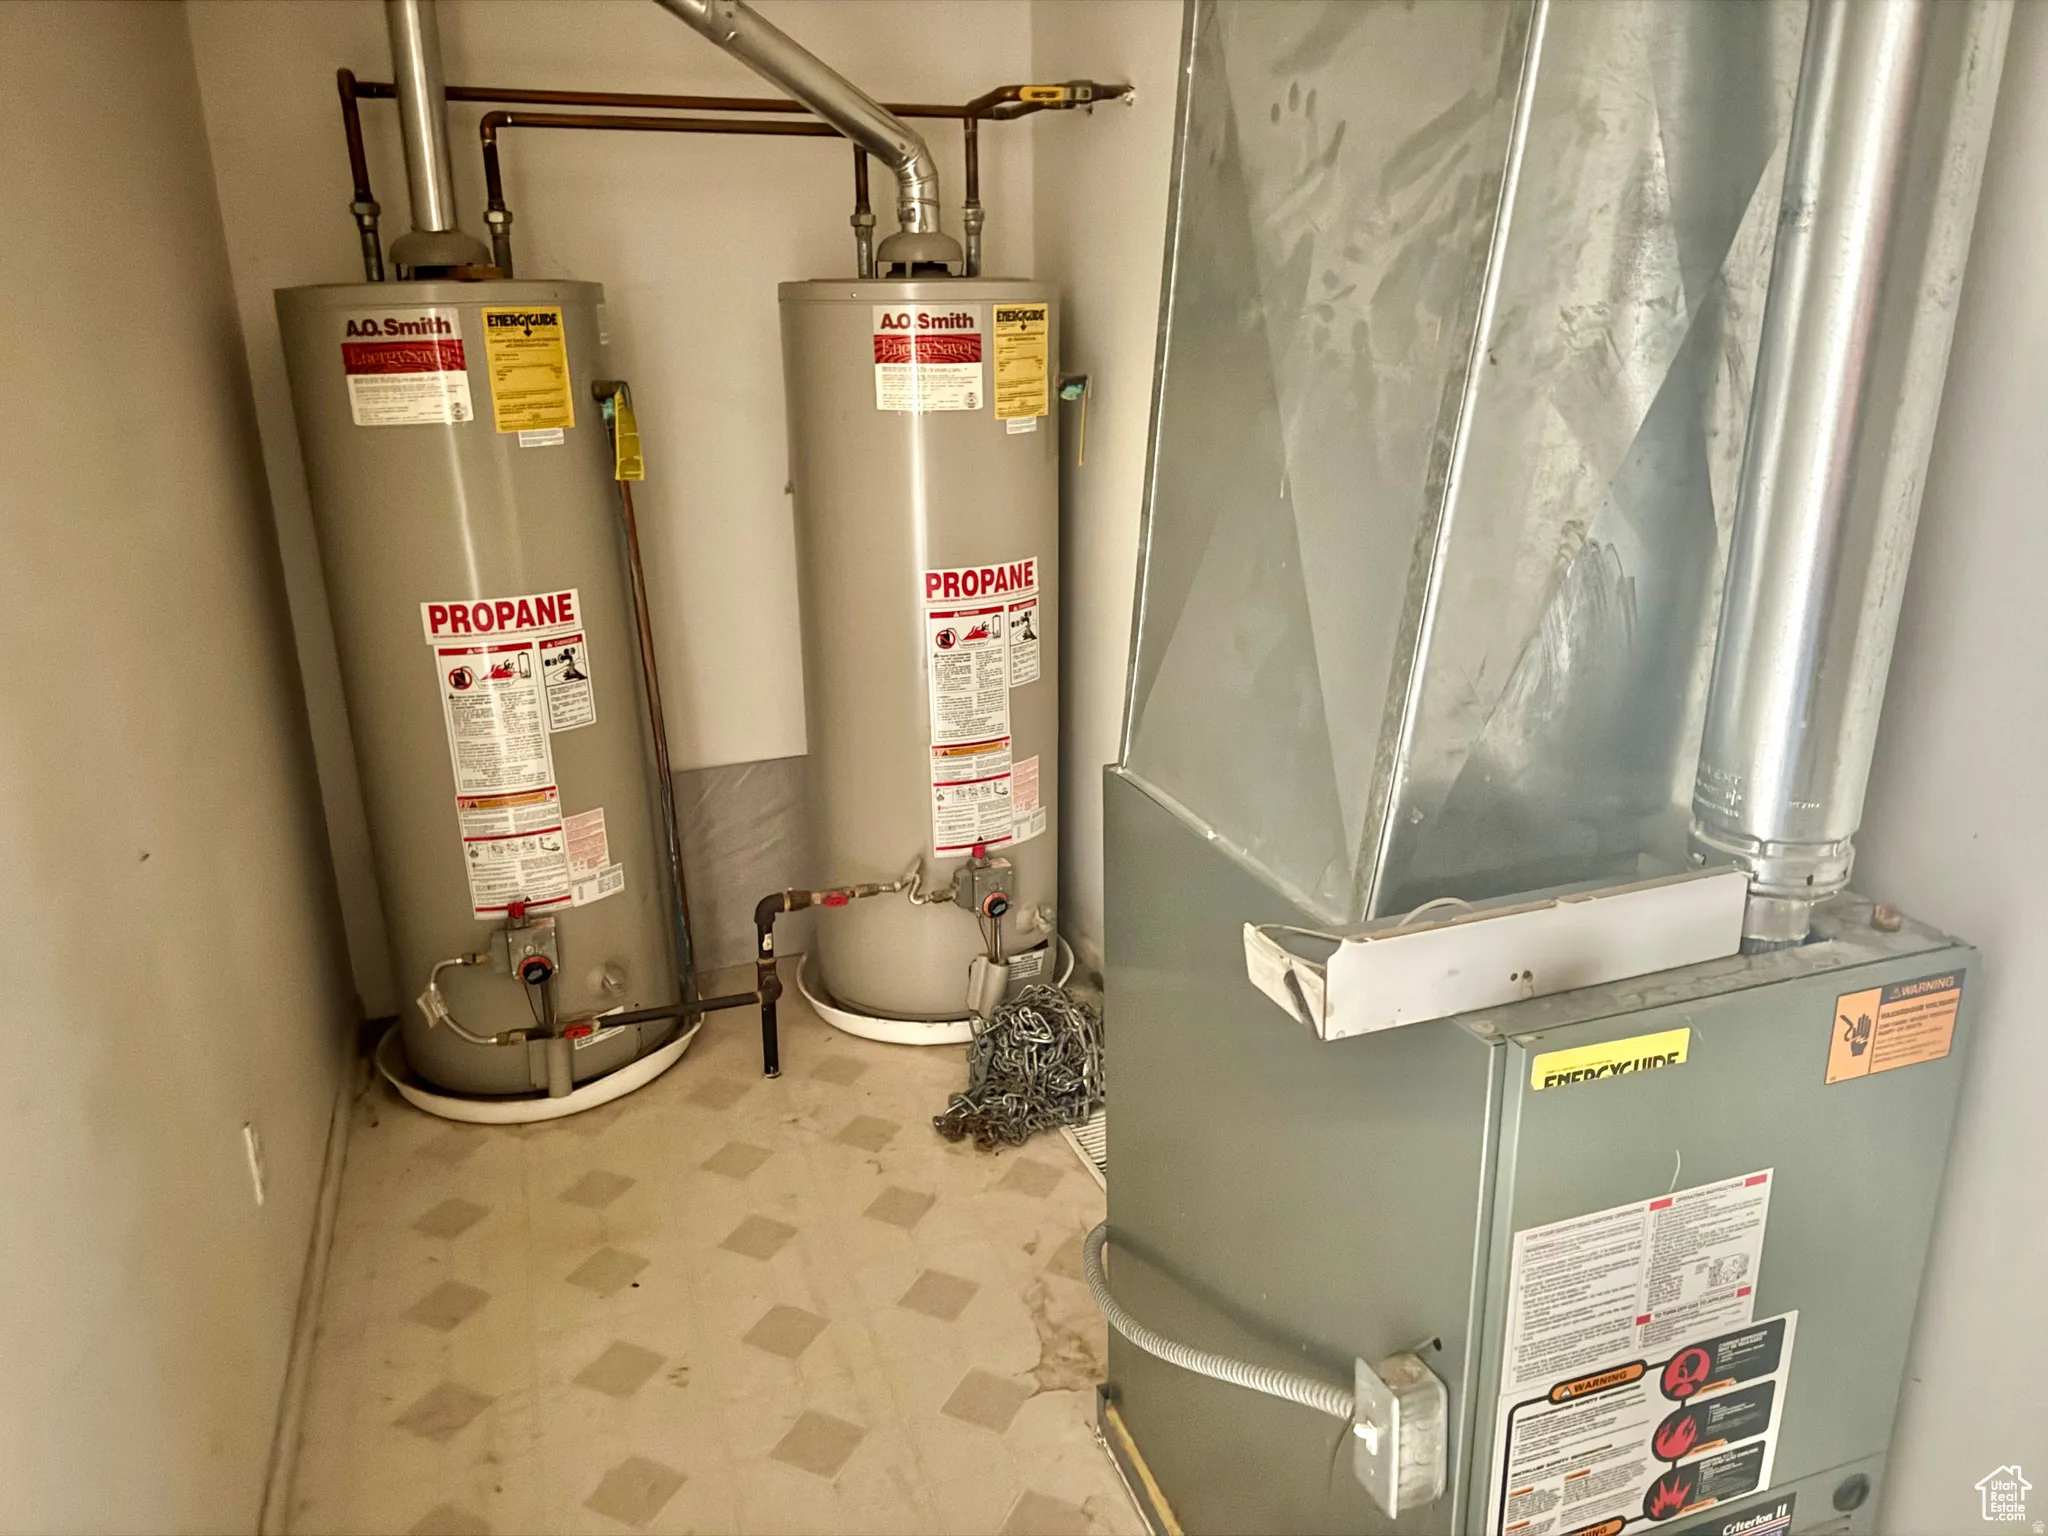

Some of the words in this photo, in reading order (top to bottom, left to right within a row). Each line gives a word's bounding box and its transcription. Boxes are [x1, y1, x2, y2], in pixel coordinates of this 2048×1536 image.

[486, 313, 558, 327] ENERGYGUIDE
[881, 313, 916, 330] A.O.
[917, 312, 974, 330] Smith
[996, 309, 1046, 322] ENERGYGUIDE
[346, 319, 382, 337] A.O.
[384, 316, 452, 336] Smith
[925, 560, 1034, 599] PROPANE
[428, 592, 575, 634] PROPANE
[1901, 975, 1954, 996] WARNING
[1573, 1370, 1628, 1393] WARNING
[1722, 1511, 1774, 1536] Criterion
